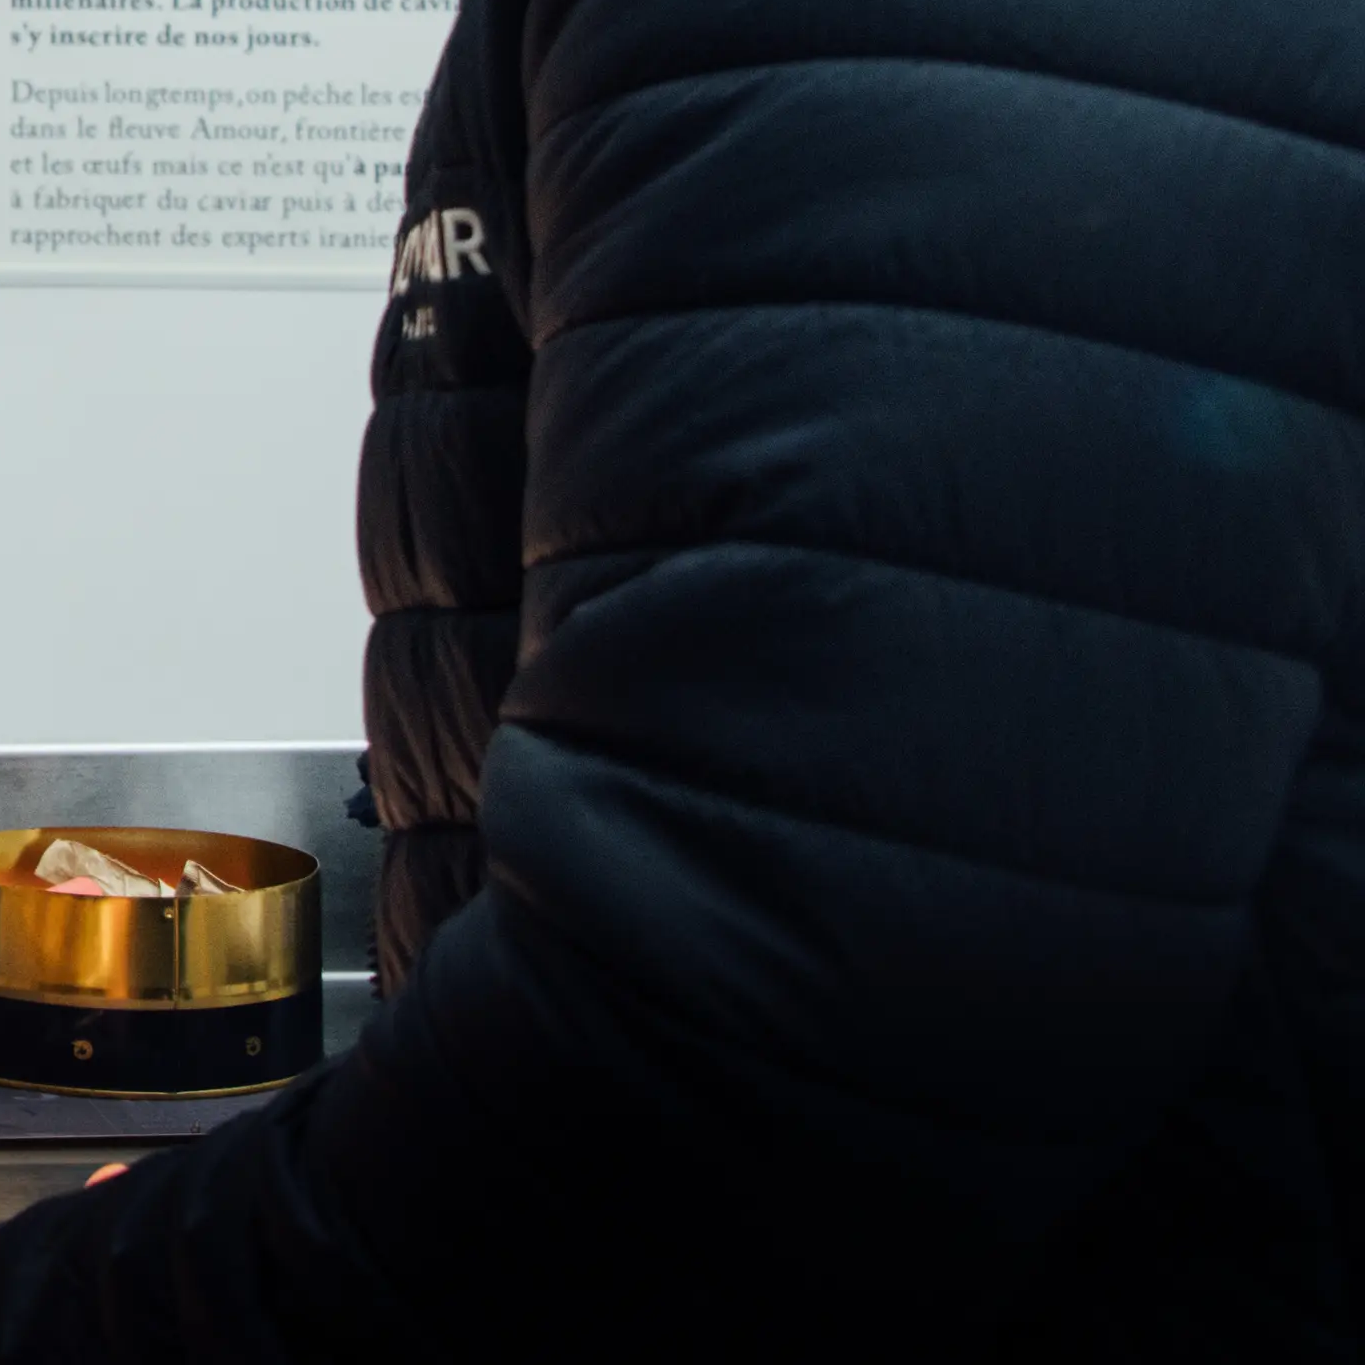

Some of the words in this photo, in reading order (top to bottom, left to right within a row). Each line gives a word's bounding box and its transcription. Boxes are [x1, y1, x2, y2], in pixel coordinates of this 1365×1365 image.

[10, 25, 43, 53] s'y
[49, 24, 148, 47] inscrire
[156, 24, 186, 47] de
[194, 31, 239, 48] nos
[244, 25, 320, 54] jours.
[10, 80, 98, 111] Depuis
[282, 82, 353, 113] pêche
[360, 81, 392, 106] les
[10, 118, 66, 141] dans
[77, 117, 97, 141] le
[108, 116, 180, 141] fleuve
[191, 118, 288, 144] Amour,
[295, 116, 406, 142] frontière
[10, 156, 32, 175] et
[42, 153, 72, 176] les
[153, 154, 208, 177] mais
[217, 161, 243, 177] ce
[252, 153, 304, 177] n'est
[10, 189, 22, 211] à
[32, 187, 145, 219] fabriquer
[157, 187, 188, 212] du
[197, 189, 271, 212] caviar
[282, 190, 333, 220] puis
[343, 191, 356, 213] à
[10, 223, 161, 253] rapprochent
[171, 224, 211, 248] des
[221, 226, 310, 255] experts
